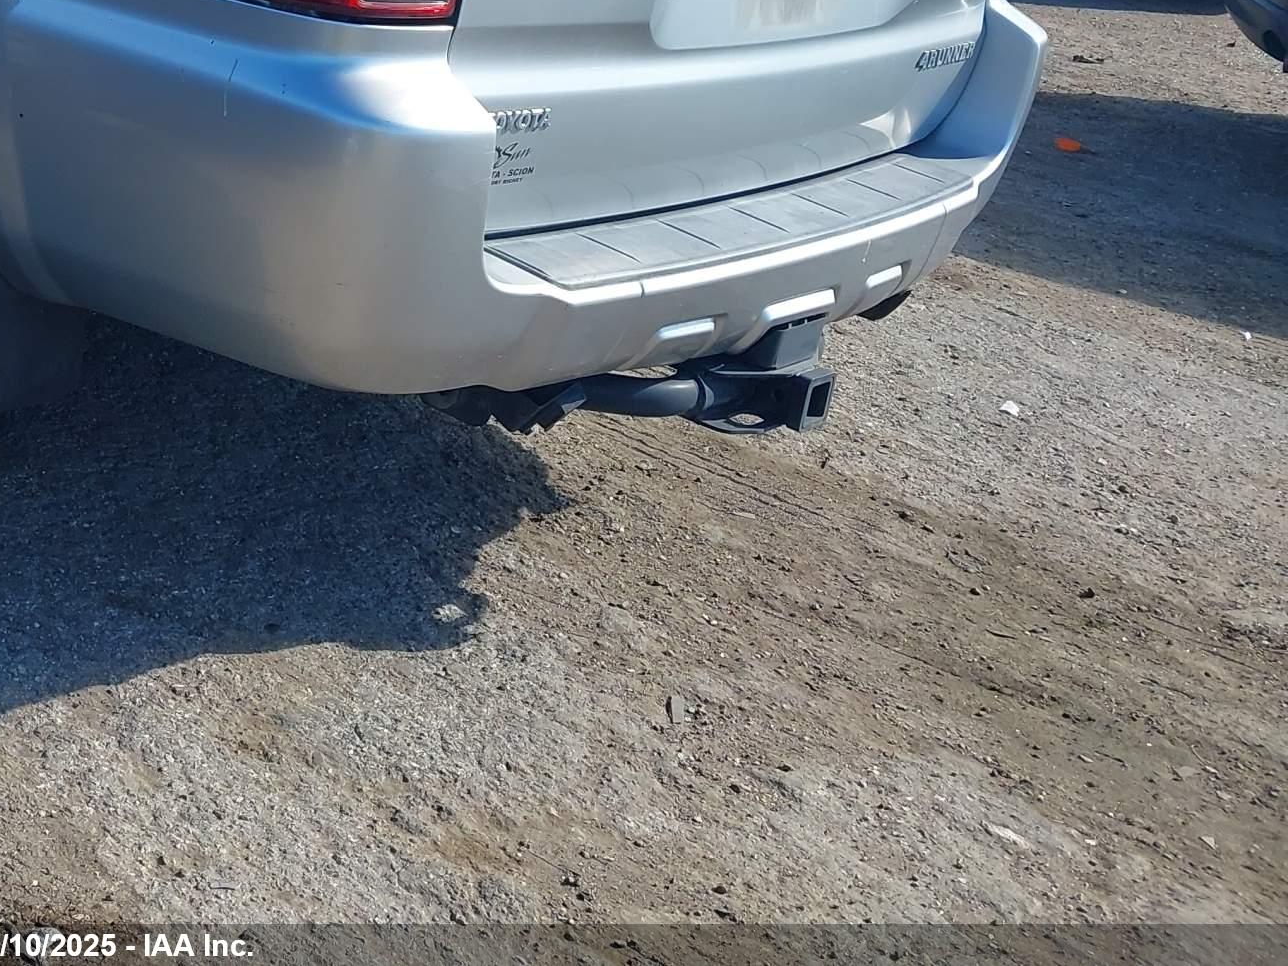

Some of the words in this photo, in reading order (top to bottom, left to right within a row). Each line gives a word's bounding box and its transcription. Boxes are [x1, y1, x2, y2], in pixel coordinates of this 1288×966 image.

[915, 42, 975, 72] 4RUNNER
[494, 108, 552, 132] OYOTA
[507, 166, 535, 177] SCION
